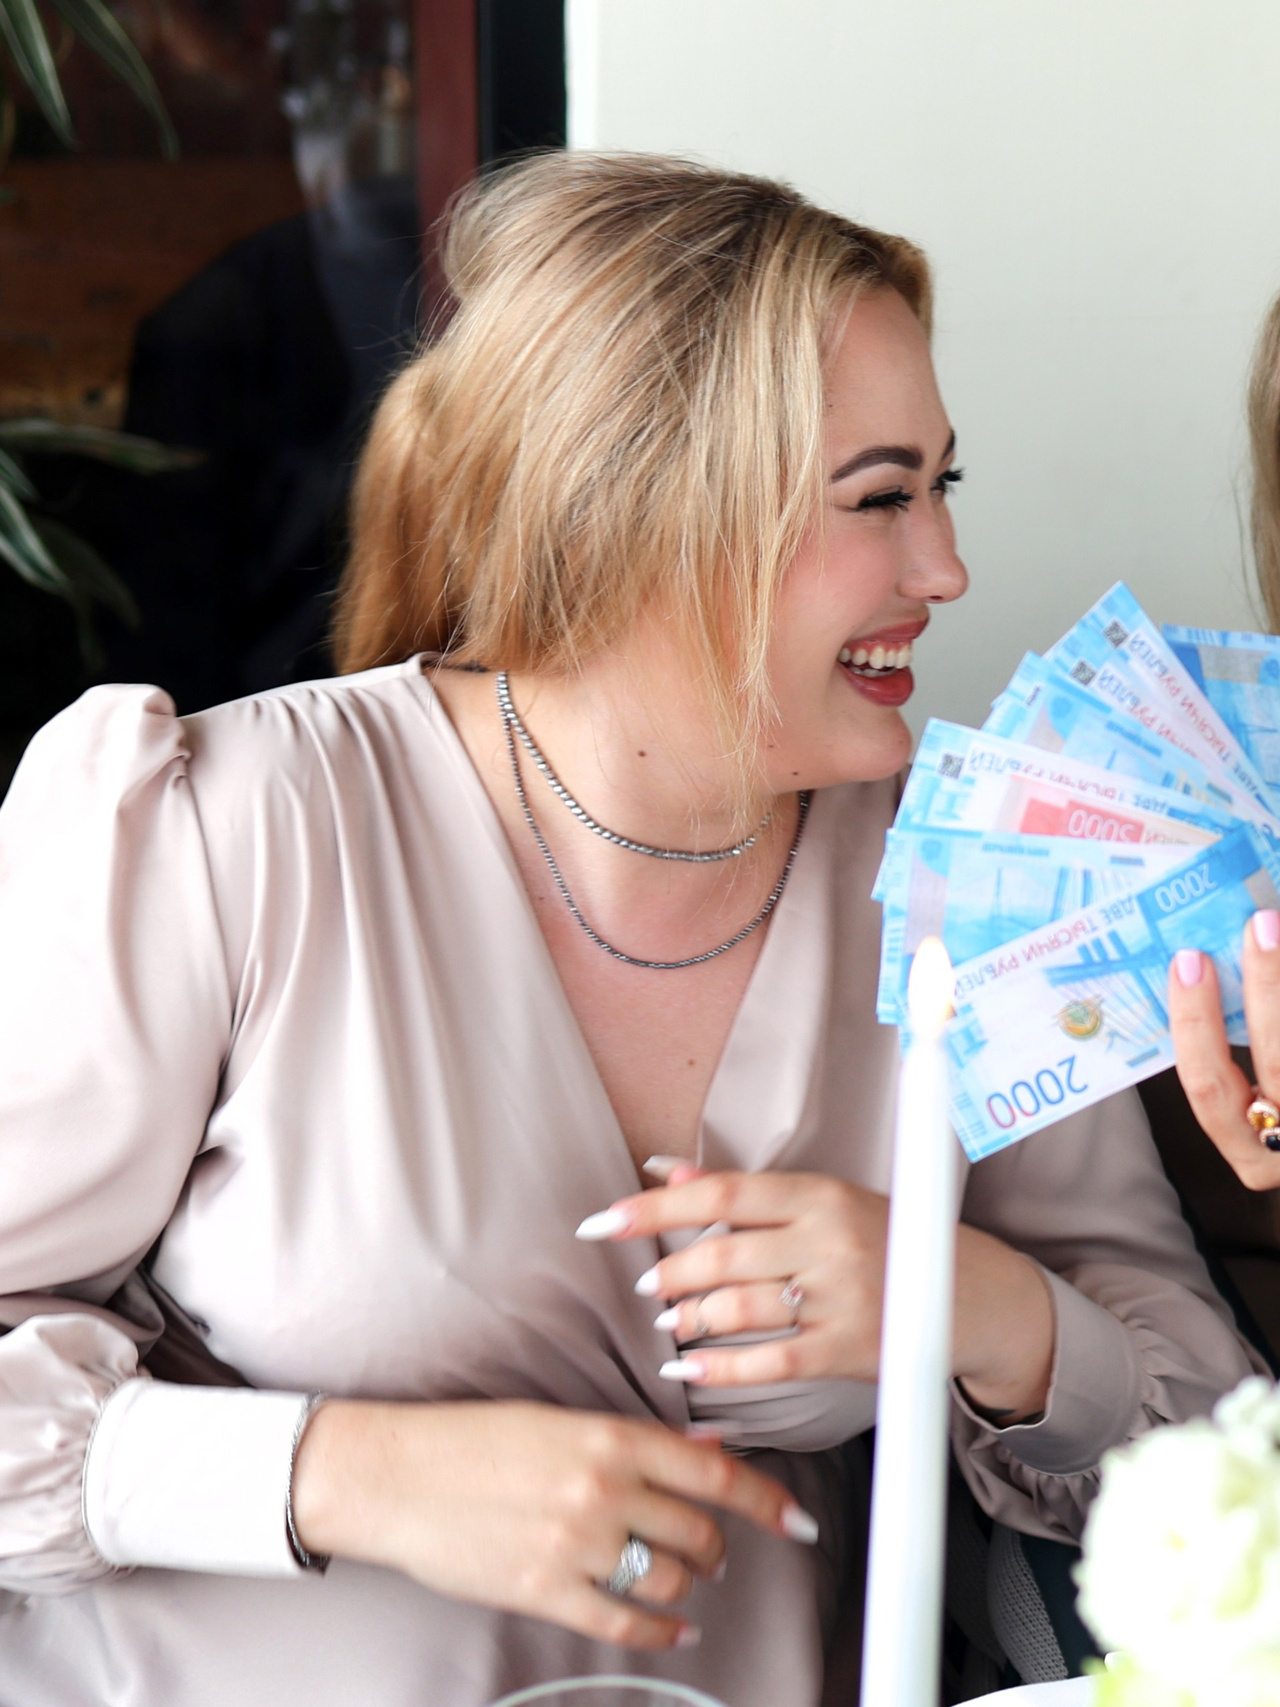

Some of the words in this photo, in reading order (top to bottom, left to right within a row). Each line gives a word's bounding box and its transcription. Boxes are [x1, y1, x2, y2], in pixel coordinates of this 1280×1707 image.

[1129, 631, 1184, 700] РУБЛЕЙ
[1099, 668, 1157, 729] РУБЛЕЙ
[1179, 694, 1233, 763] ТЫСЯЧИ
[1102, 896, 1136, 929] ДВЕ
[1153, 861, 1218, 913] 2000
[1024, 916, 1099, 963] ТЫСЯЧИ
[986, 1054, 1090, 1129] 2000
